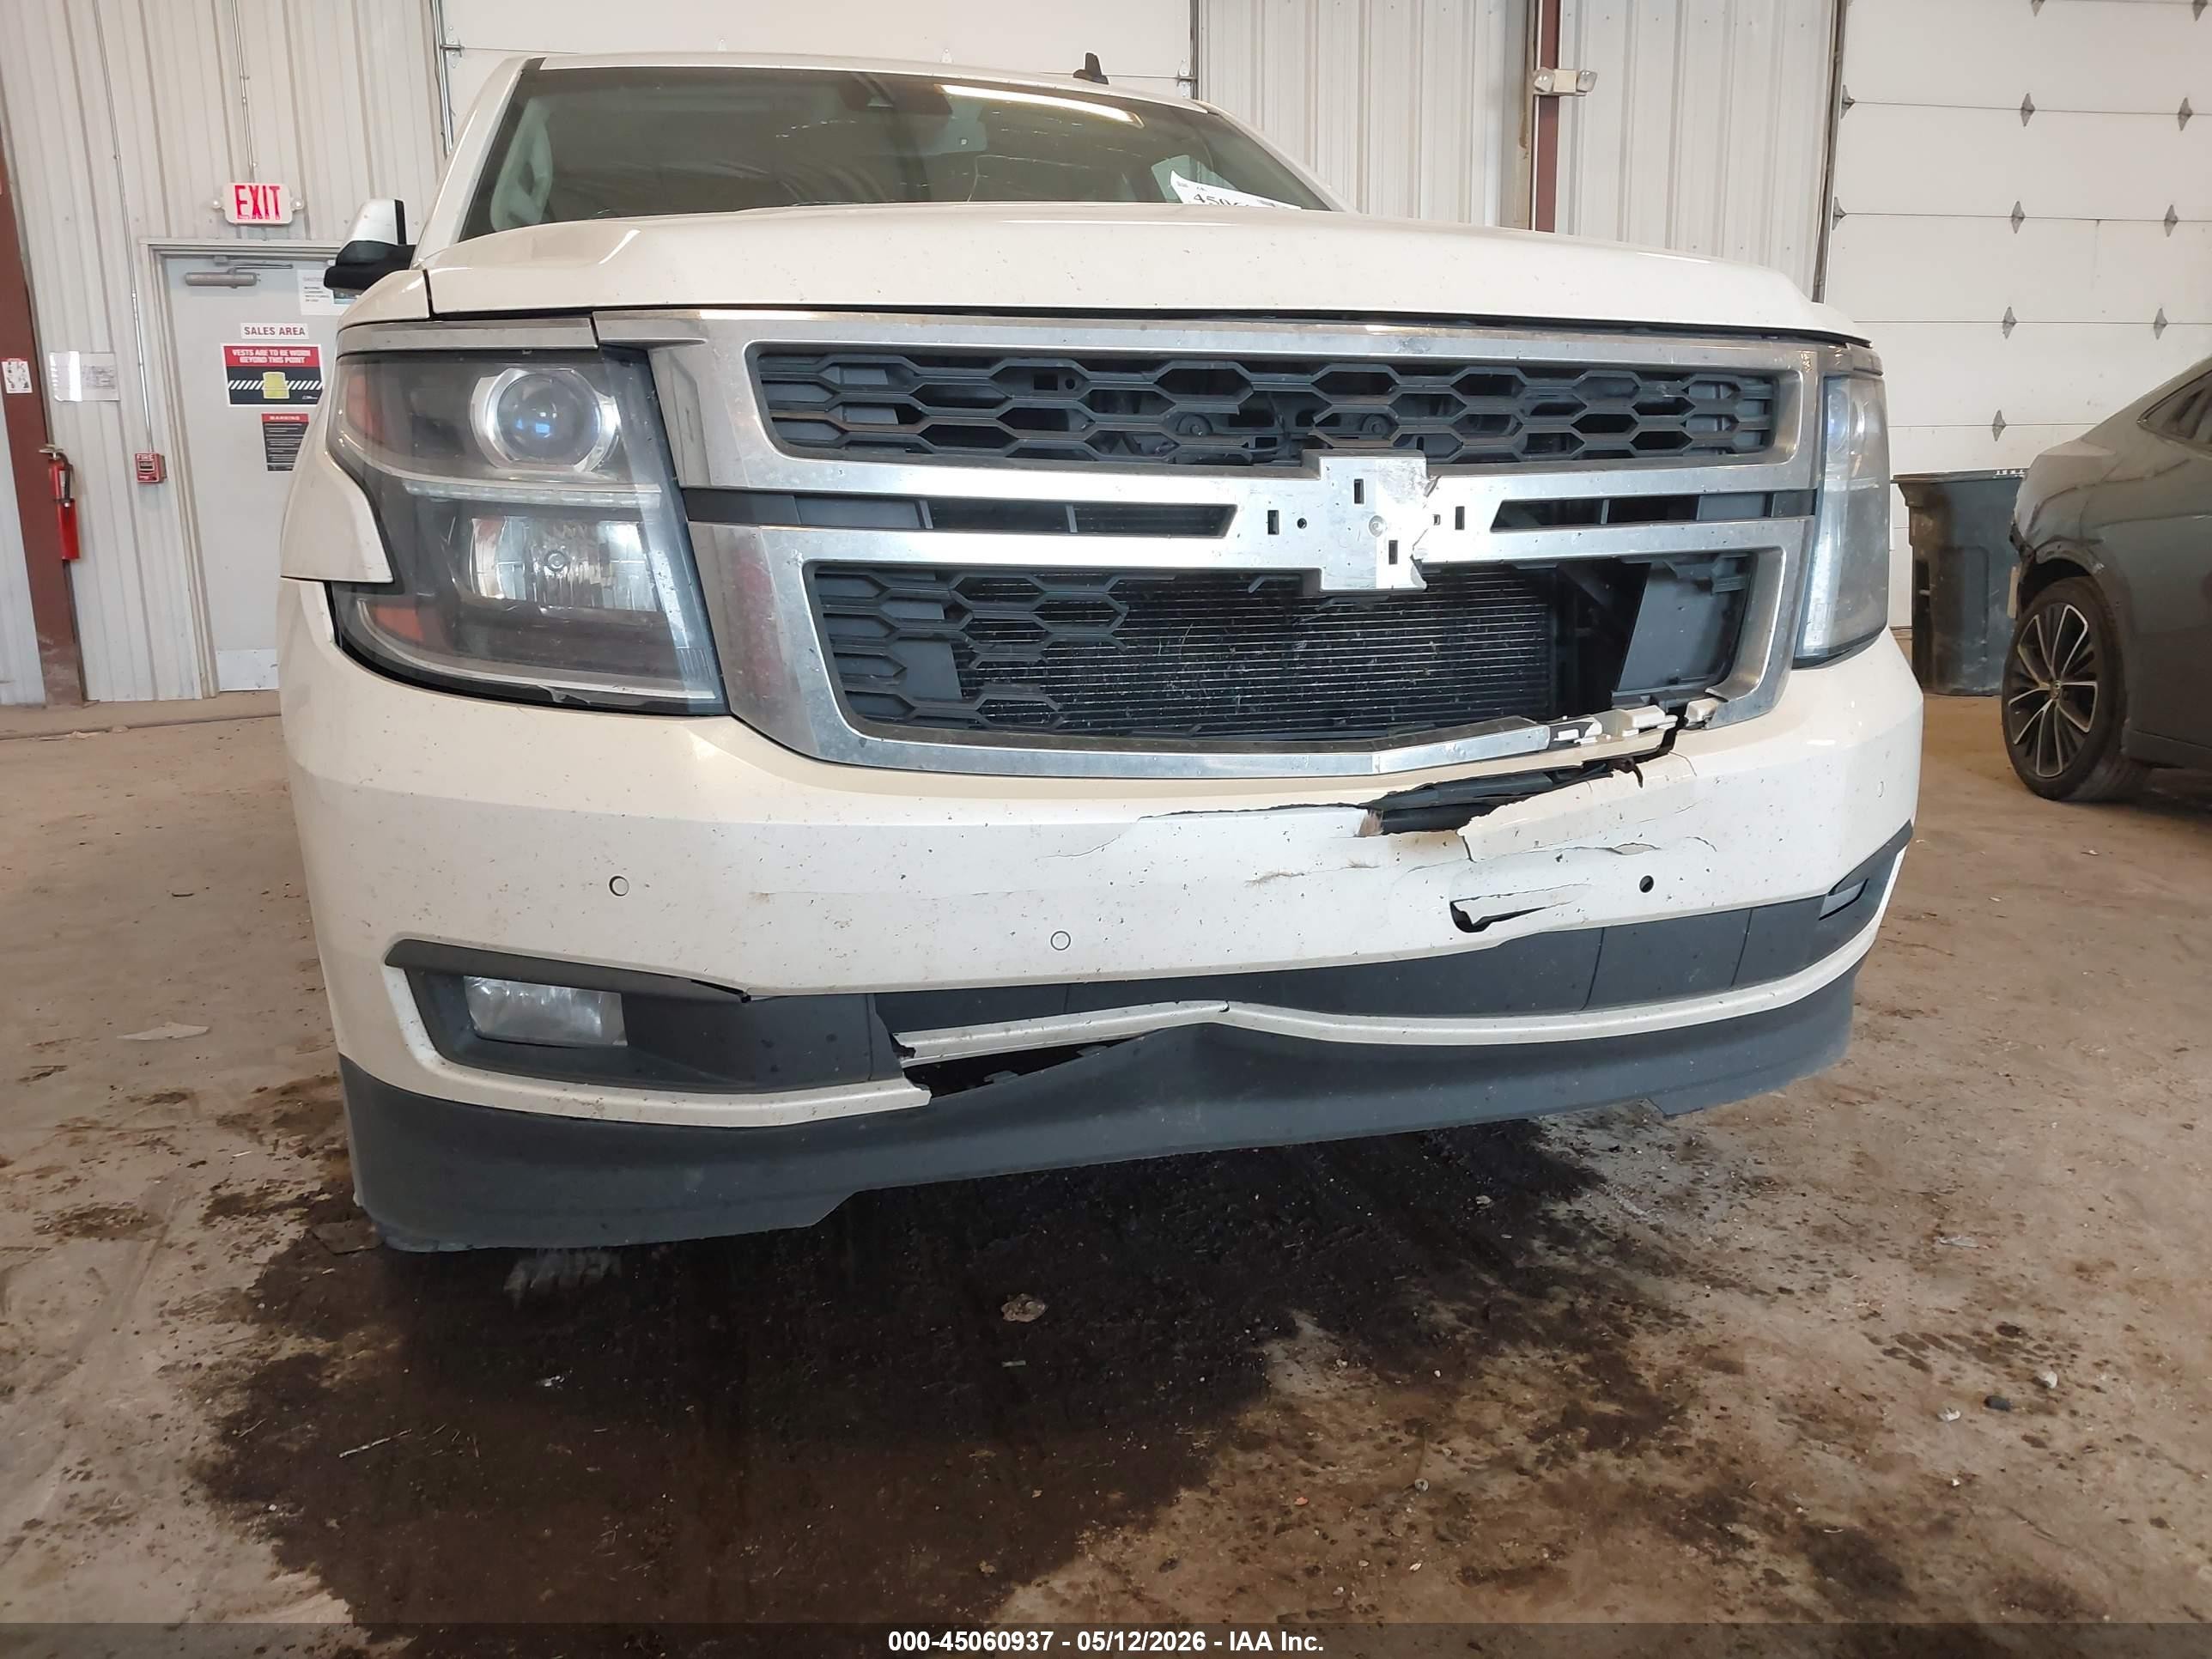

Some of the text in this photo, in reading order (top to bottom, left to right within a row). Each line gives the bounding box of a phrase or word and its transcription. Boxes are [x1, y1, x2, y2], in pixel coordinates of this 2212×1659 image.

[234, 185, 281, 220] EXIT
[244, 326, 306, 336] SALES AREA
